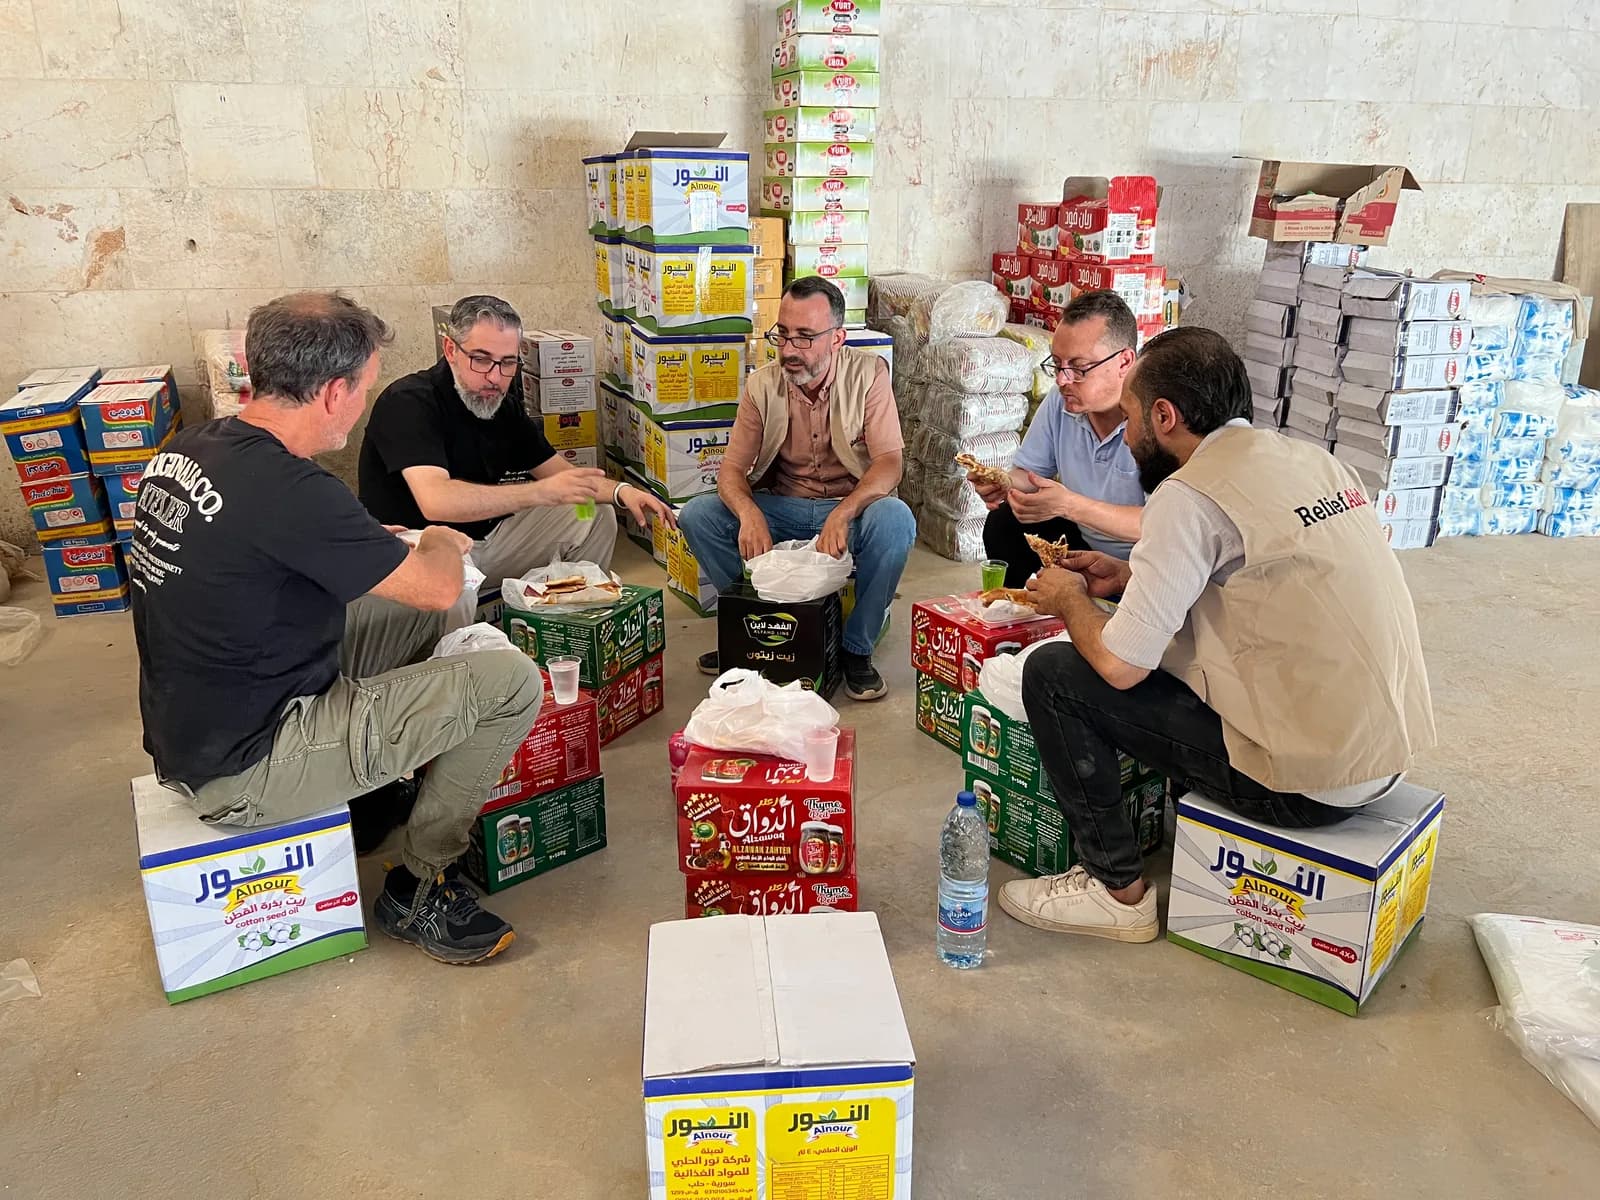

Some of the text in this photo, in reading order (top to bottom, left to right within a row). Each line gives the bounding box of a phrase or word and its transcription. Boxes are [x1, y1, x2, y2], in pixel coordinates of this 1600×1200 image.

[673, 165, 728, 186] النور
[690, 182, 717, 192] Alnour
[1078, 210, 1092, 229] ريان
[663, 264, 693, 274] النور
[1010, 258, 1020, 275] ريان
[1048, 263, 1058, 282] ريان
[1090, 268, 1101, 288] ريان
[657, 353, 687, 364] النور
[700, 352, 730, 364] النور
[686, 432, 730, 454] نور
[704, 448, 726, 456] Alnou
[140, 452, 224, 523] RIGINALS CO.
[138, 482, 190, 534] ATELIER
[1294, 487, 1367, 528] ReliefAid
[932, 627, 961, 655] الذواق
[746, 650, 795, 662] زيت زيتون
[935, 690, 964, 720] الذواق
[804, 797, 842, 813] Thyme
[728, 801, 796, 838] الذواق
[742, 832, 785, 844] Alzawaq
[195, 843, 314, 903] النور
[1210, 846, 1326, 900] النور
[235, 877, 293, 900] Alnour
[812, 883, 849, 898] Thyme
[1243, 878, 1297, 906] Alnour
[224, 896, 306, 925] زيت بذرة القطن
[235, 908, 299, 929] cotton seed oil
[1227, 894, 1306, 932] زيت بذرة القطن
[1263, 917, 1284, 932] seed
[1284, 924, 1296, 936] oil
[1340, 950, 1354, 960] 4X4
[667, 1112, 749, 1138] النور
[788, 1104, 870, 1132] النور
[693, 1131, 732, 1142] Alnour
[814, 1124, 853, 1136] Alnour
[672, 1155, 751, 1168] شركة نور الحلبي
[701, 1148, 723, 1156] تعبئة
[674, 1167, 749, 1179] للمواد الغذائية
